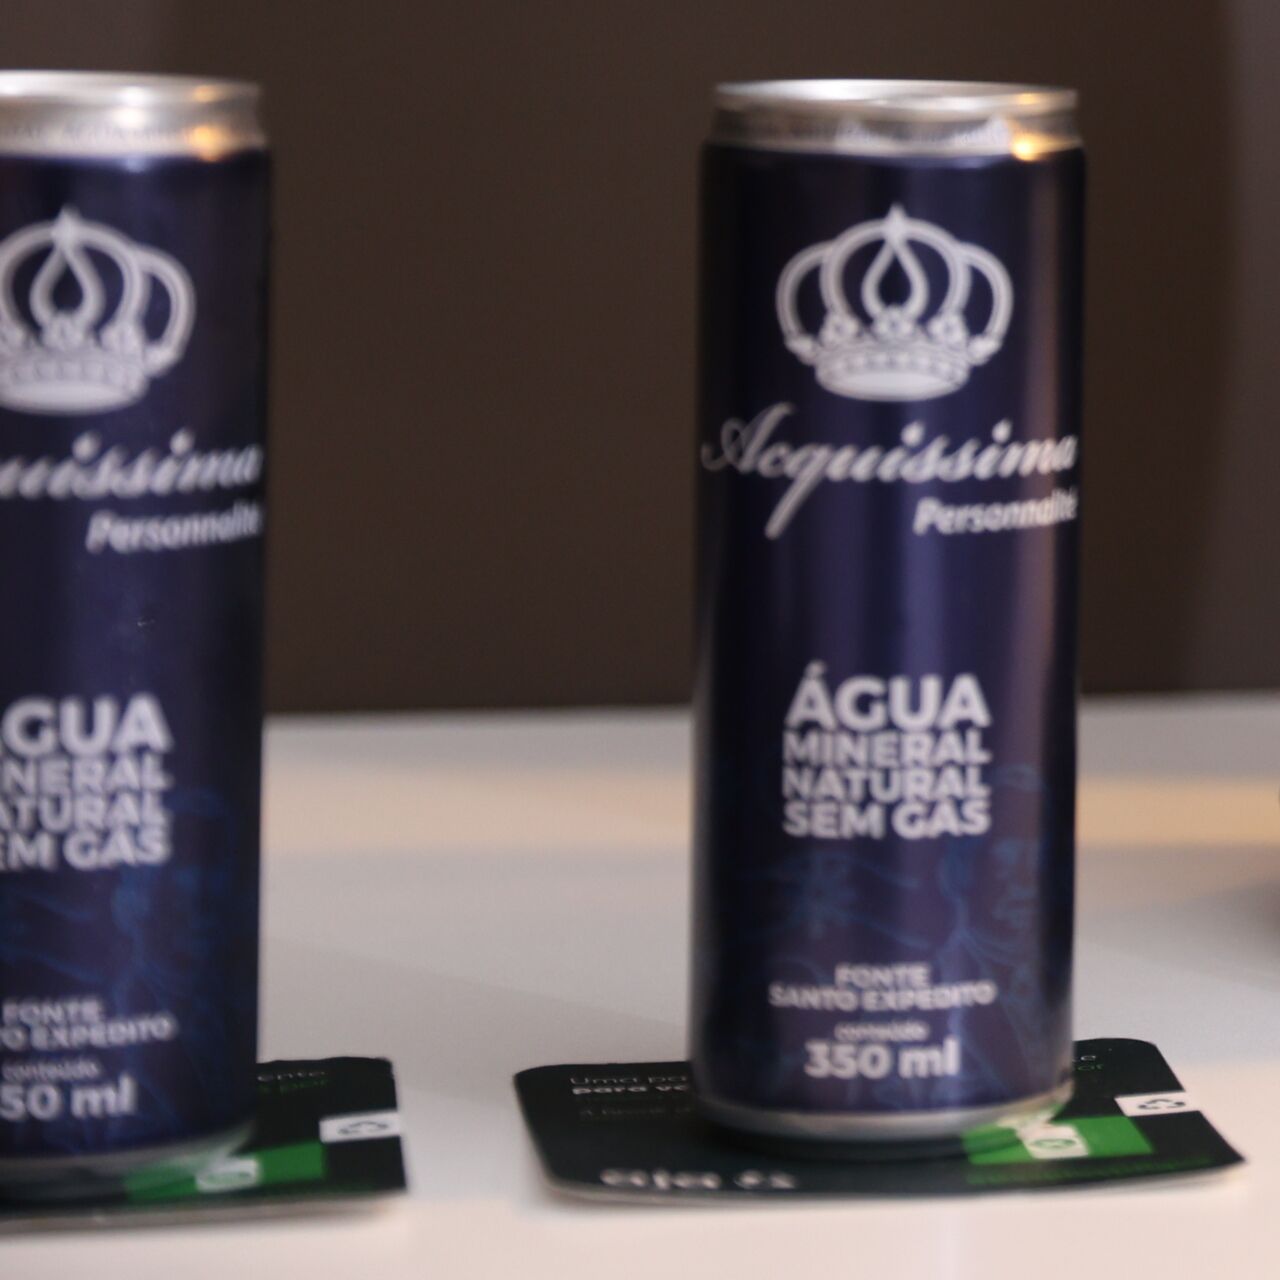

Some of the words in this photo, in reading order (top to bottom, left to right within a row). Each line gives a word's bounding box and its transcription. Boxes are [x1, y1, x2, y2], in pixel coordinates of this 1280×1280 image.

[701, 402, 1078, 540] Acquissima
[784, 659, 993, 732] ÁGUA
[0, 691, 175, 759] GUA
[783, 728, 993, 770] MINERAL
[0, 752, 174, 799] NERAL
[782, 765, 991, 803] NATURAL
[0, 790, 170, 834] TURAL
[782, 800, 886, 839] SEM
[890, 798, 992, 839] GAS
[62, 823, 171, 871] GAS
[768, 980, 858, 1011] SANTO
[862, 978, 998, 1011] EXPEDITO
[834, 961, 932, 990] FONTE
[2, 997, 105, 1025] FONTE
[804, 1038, 892, 1080] 350
[899, 1033, 962, 1079] ml
[0, 1080, 63, 1121] 50
[71, 1070, 137, 1118] ml
